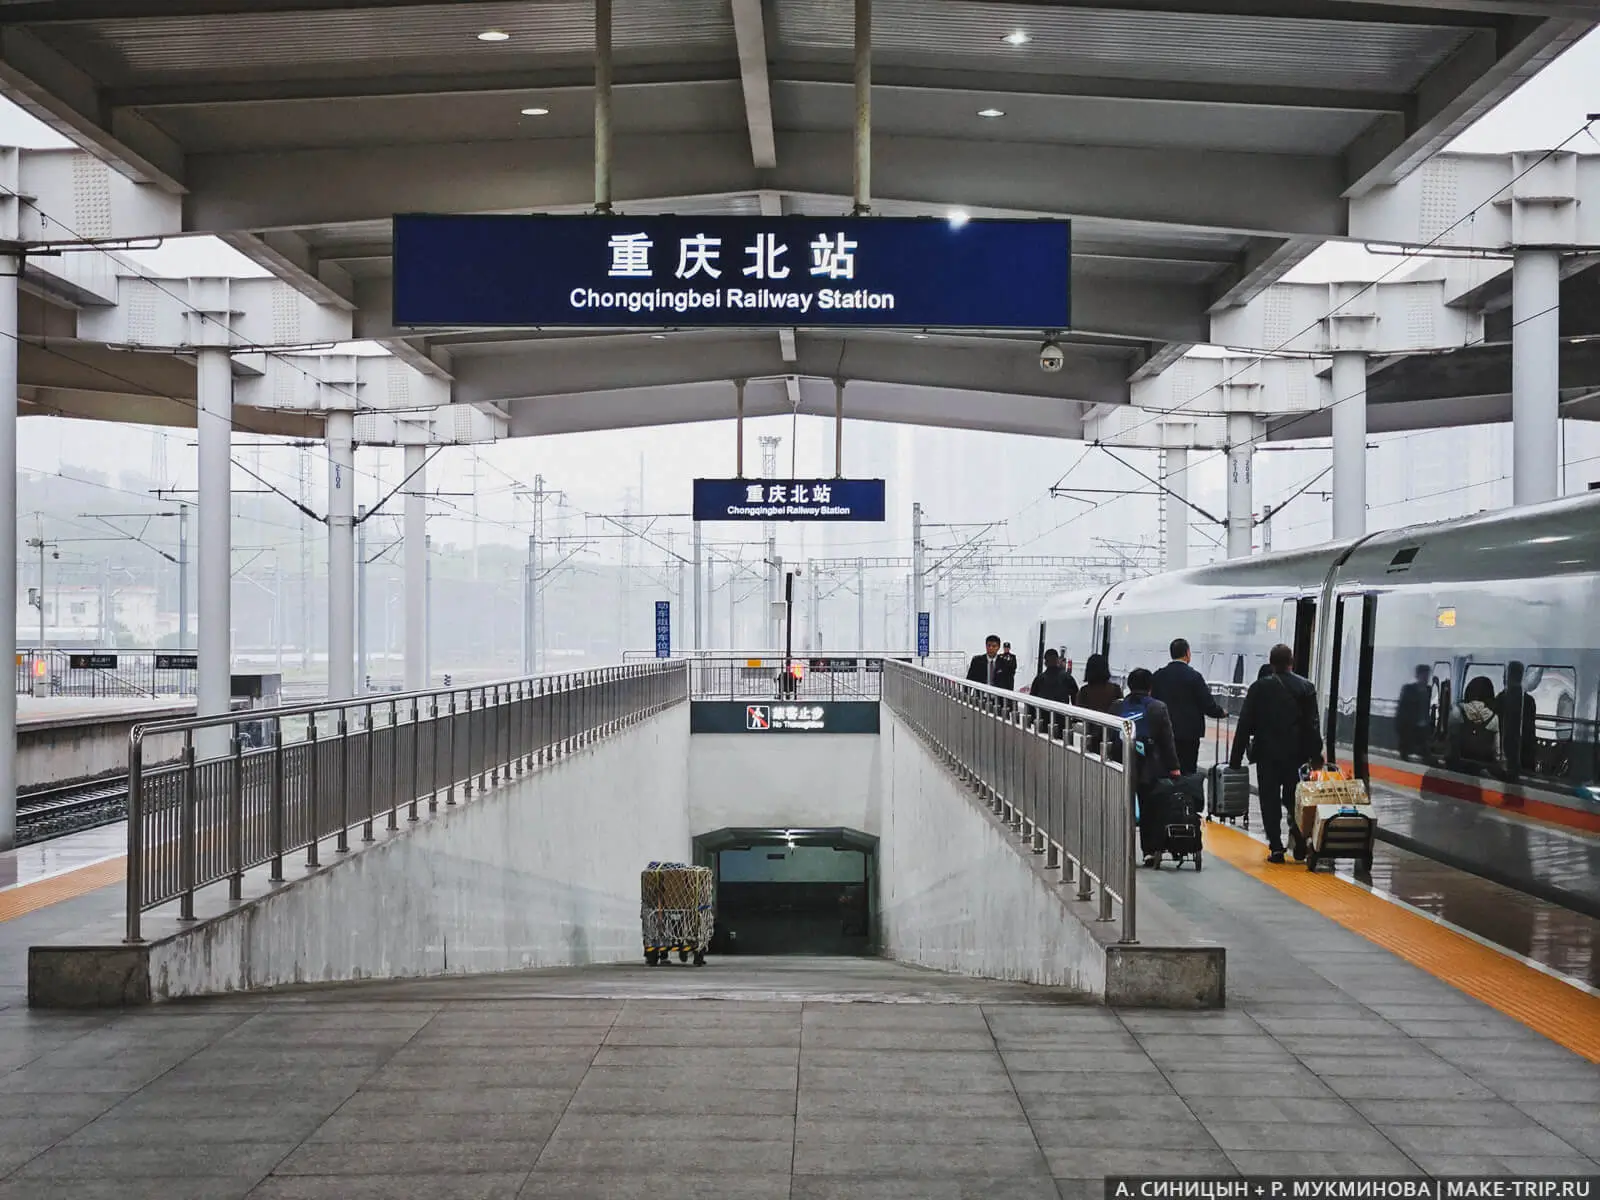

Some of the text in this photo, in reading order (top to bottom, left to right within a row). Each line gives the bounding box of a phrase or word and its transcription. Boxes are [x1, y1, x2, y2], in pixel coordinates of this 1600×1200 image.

[607, 232, 858, 280] 重庆北站
[569, 287, 895, 314] Chongqingbei Railway Station
[746, 484, 832, 503] 重庆北站
[727, 506, 850, 516] Chongqingbei Railway Station
